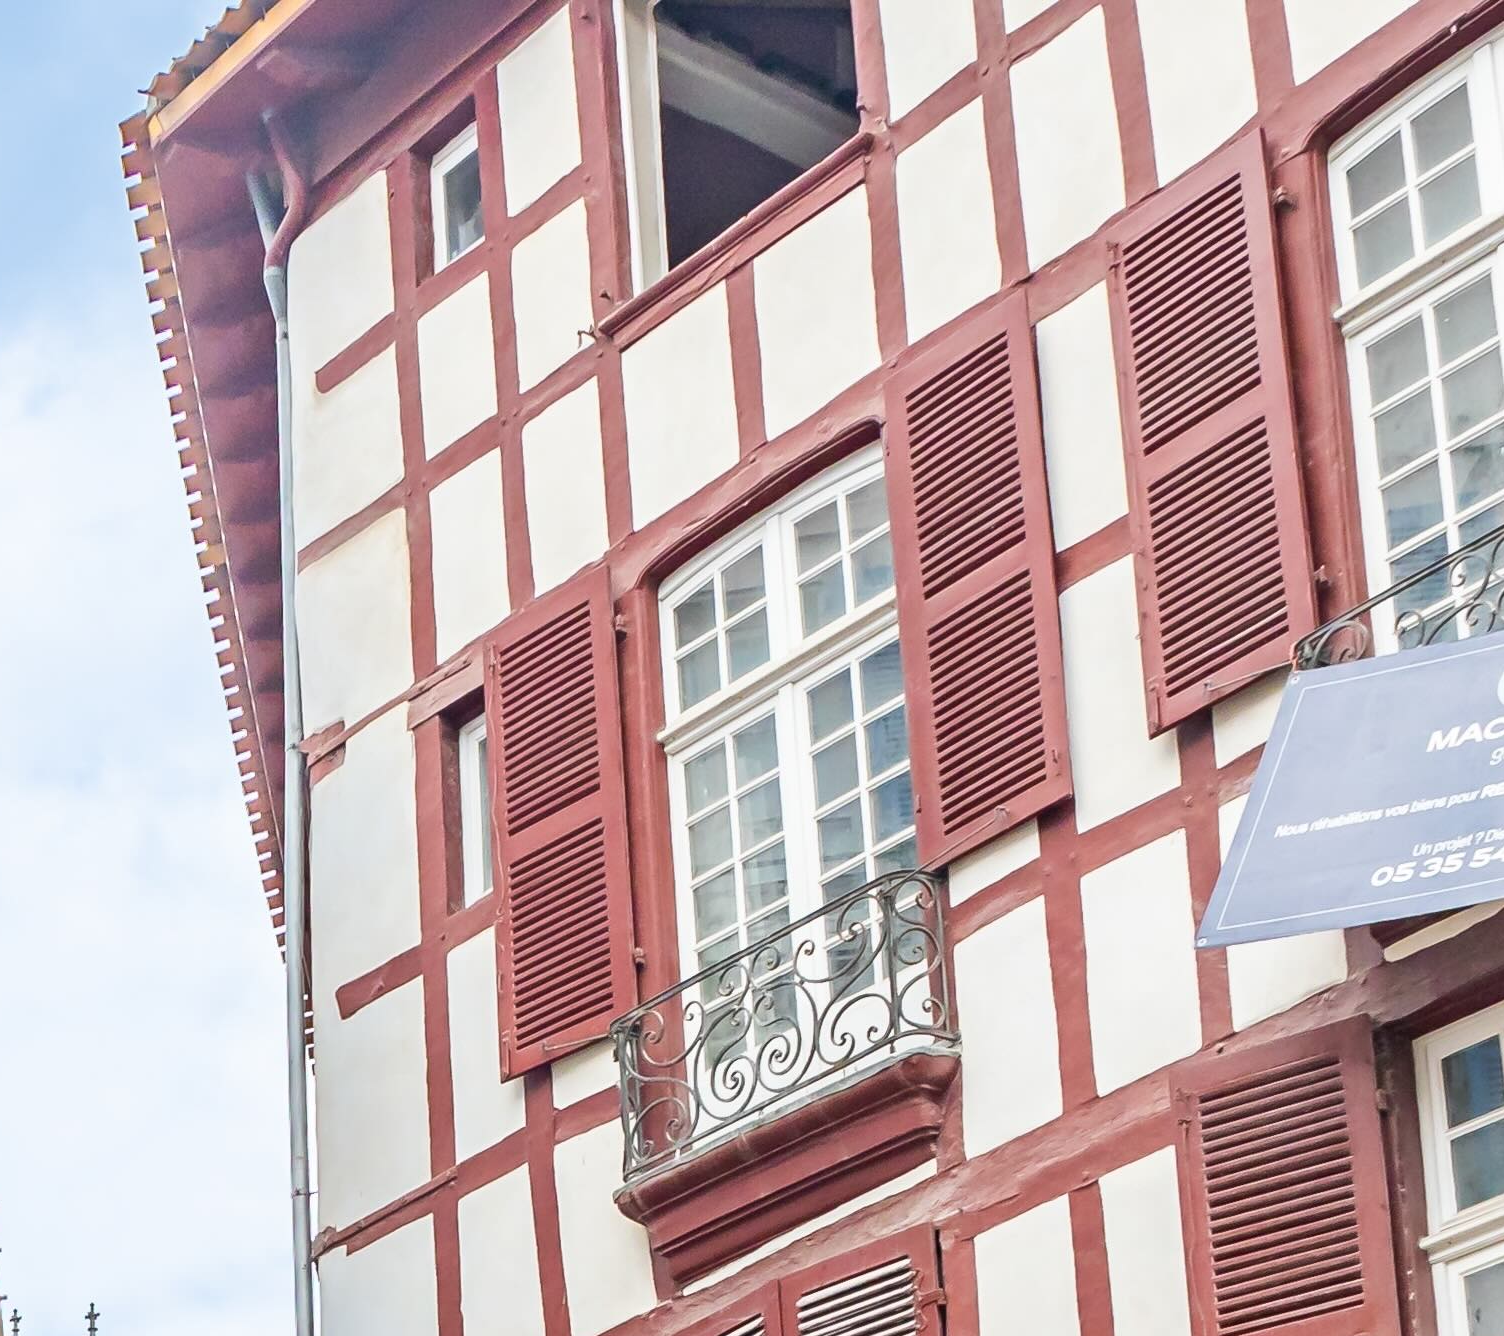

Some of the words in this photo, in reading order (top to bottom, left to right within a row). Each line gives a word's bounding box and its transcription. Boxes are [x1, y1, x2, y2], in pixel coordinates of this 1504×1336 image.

[1274, 823, 1309, 839] Nous
[1385, 803, 1410, 818] vos
[1446, 790, 1480, 809] pour
[1412, 843, 1433, 858] Un
[1433, 834, 1473, 856] projet
[1370, 861, 1417, 888] 05
[1419, 851, 1466, 879] 35
